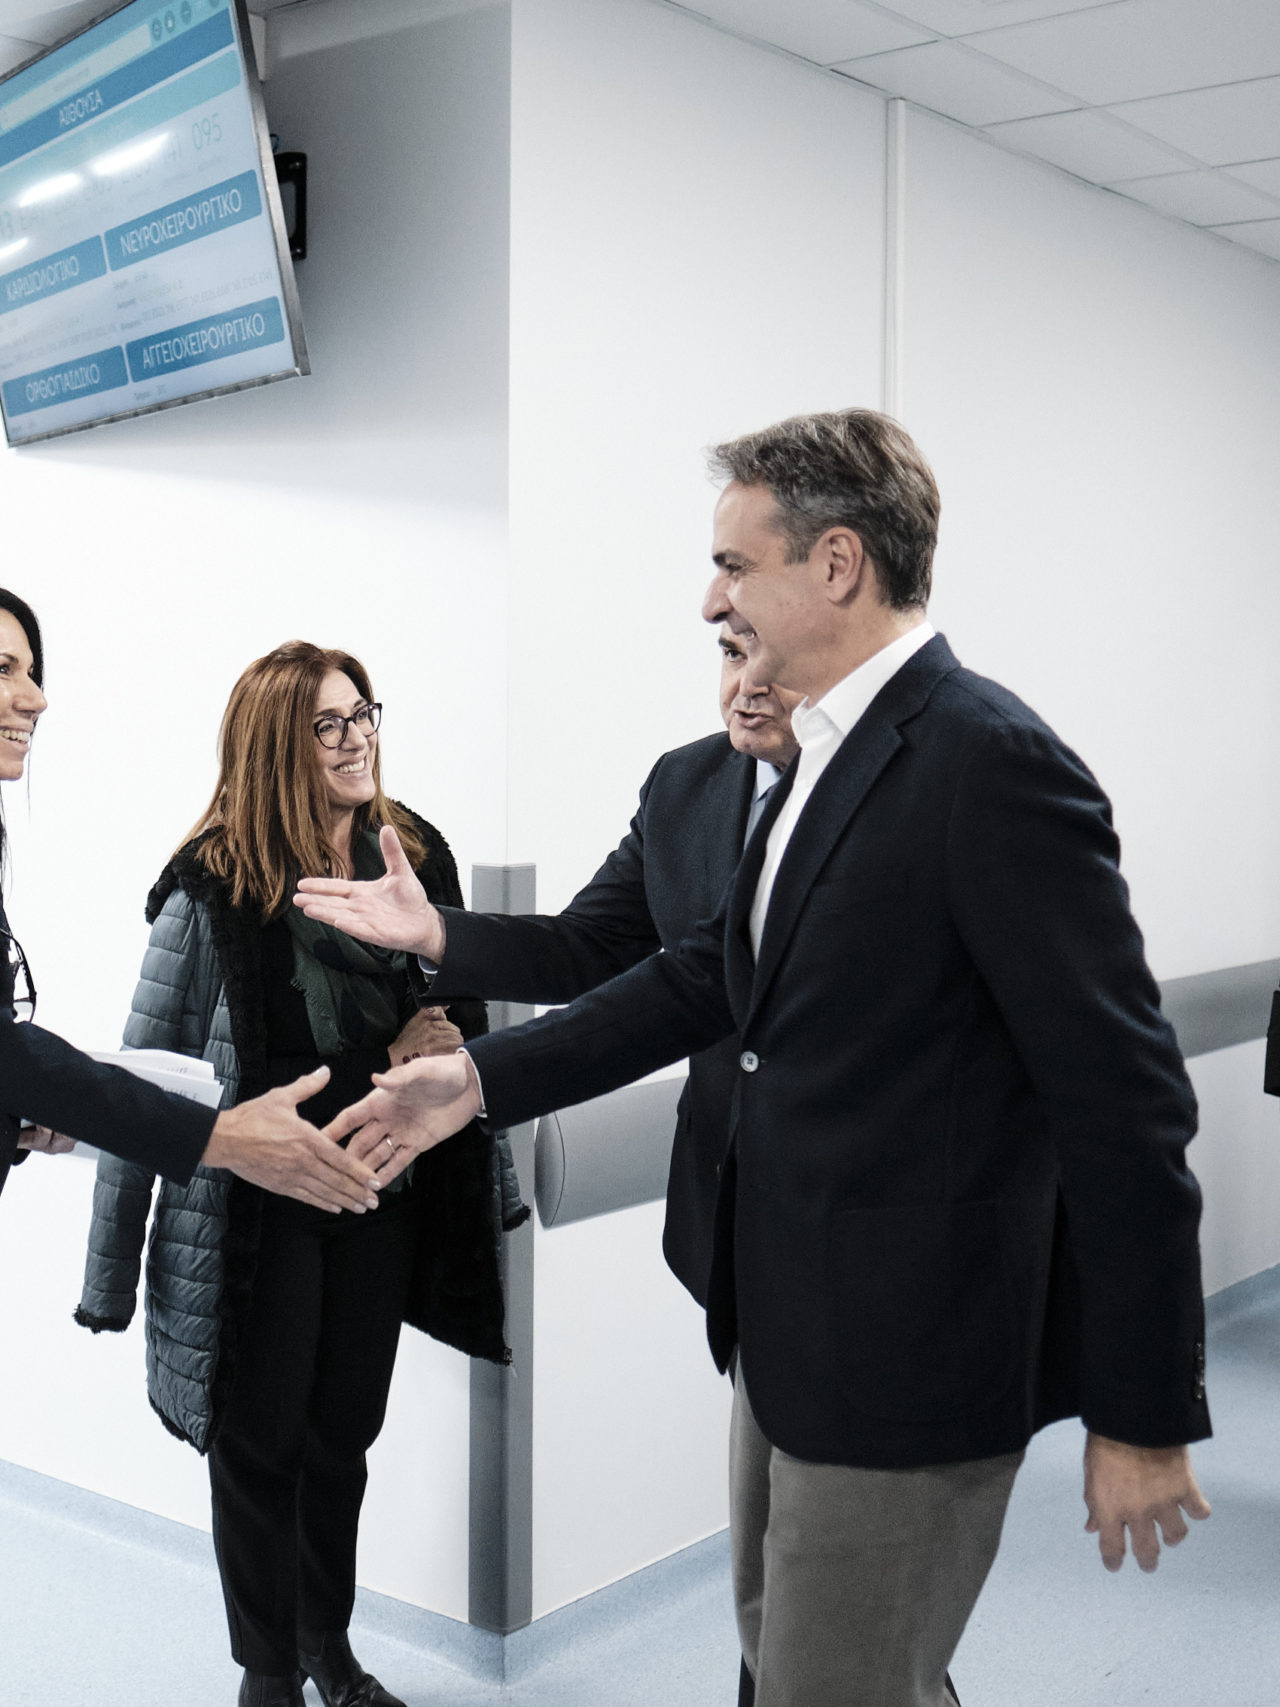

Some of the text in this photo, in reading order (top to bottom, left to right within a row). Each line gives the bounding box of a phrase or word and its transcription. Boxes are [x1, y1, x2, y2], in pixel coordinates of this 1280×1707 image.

[191, 114, 223, 152] 095
[120, 188, 243, 258] ΝΕΥΡΟΧΕΙΡΟΥΡΓΙΚΟ
[142, 312, 266, 371] ΑΓΓΕΙΟΧΕΙΡΟΥΡΓΙΚΟ
[25, 362, 101, 404] ΟΡΘΟΠΑΙΔΙΚΟ
